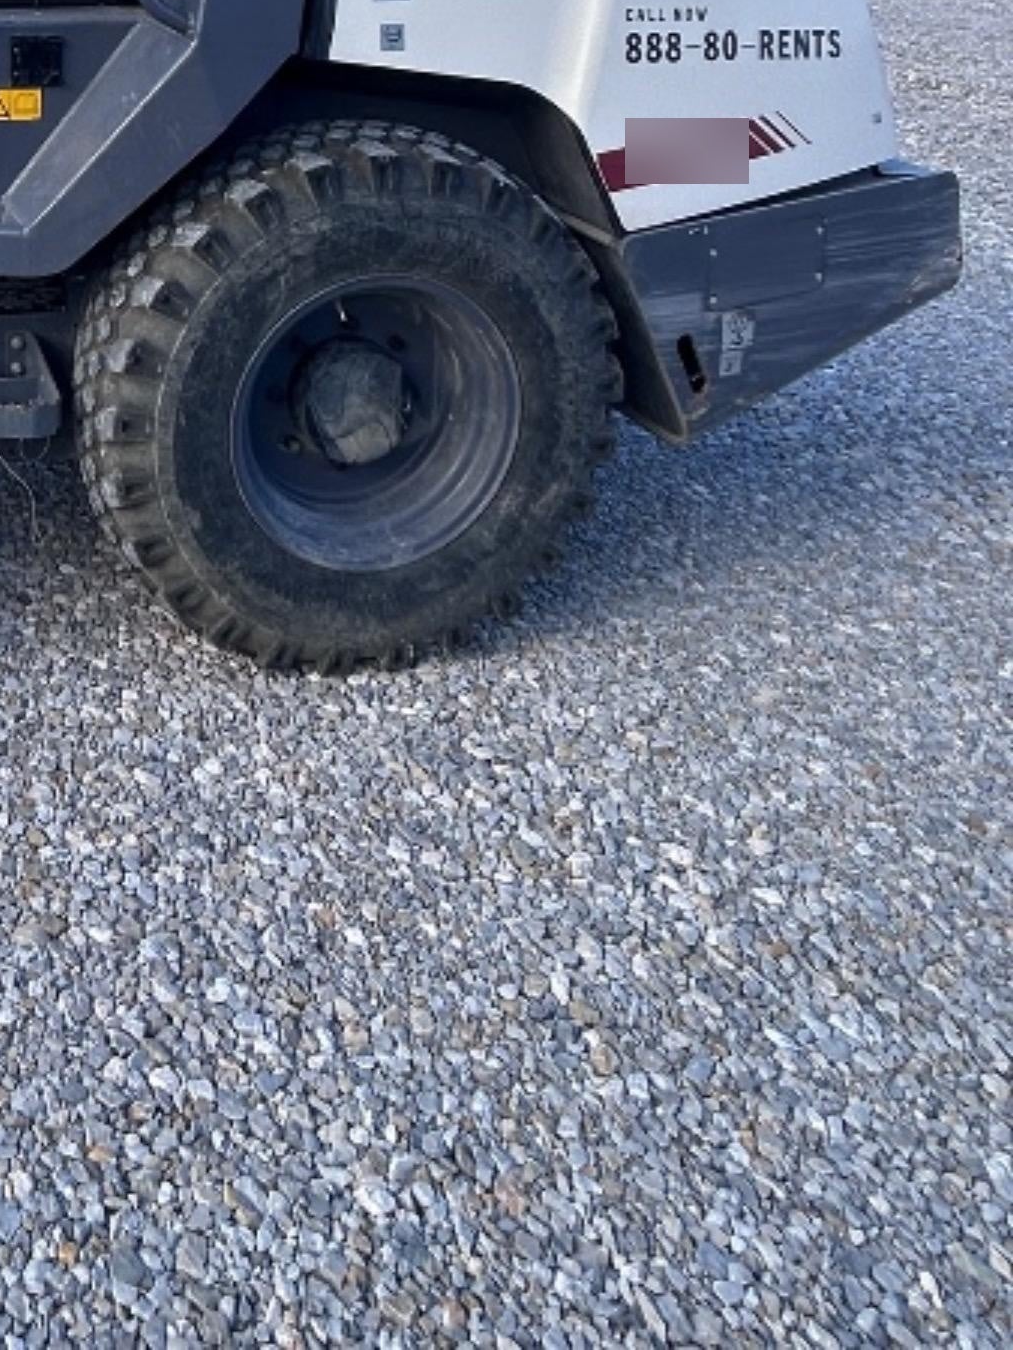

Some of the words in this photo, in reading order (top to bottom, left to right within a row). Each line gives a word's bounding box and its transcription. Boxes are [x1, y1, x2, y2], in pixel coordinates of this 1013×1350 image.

[625, 8, 666, 22] CALL
[673, 8, 708, 22] NOW
[625, 29, 842, 63] 888-80-RENTS
